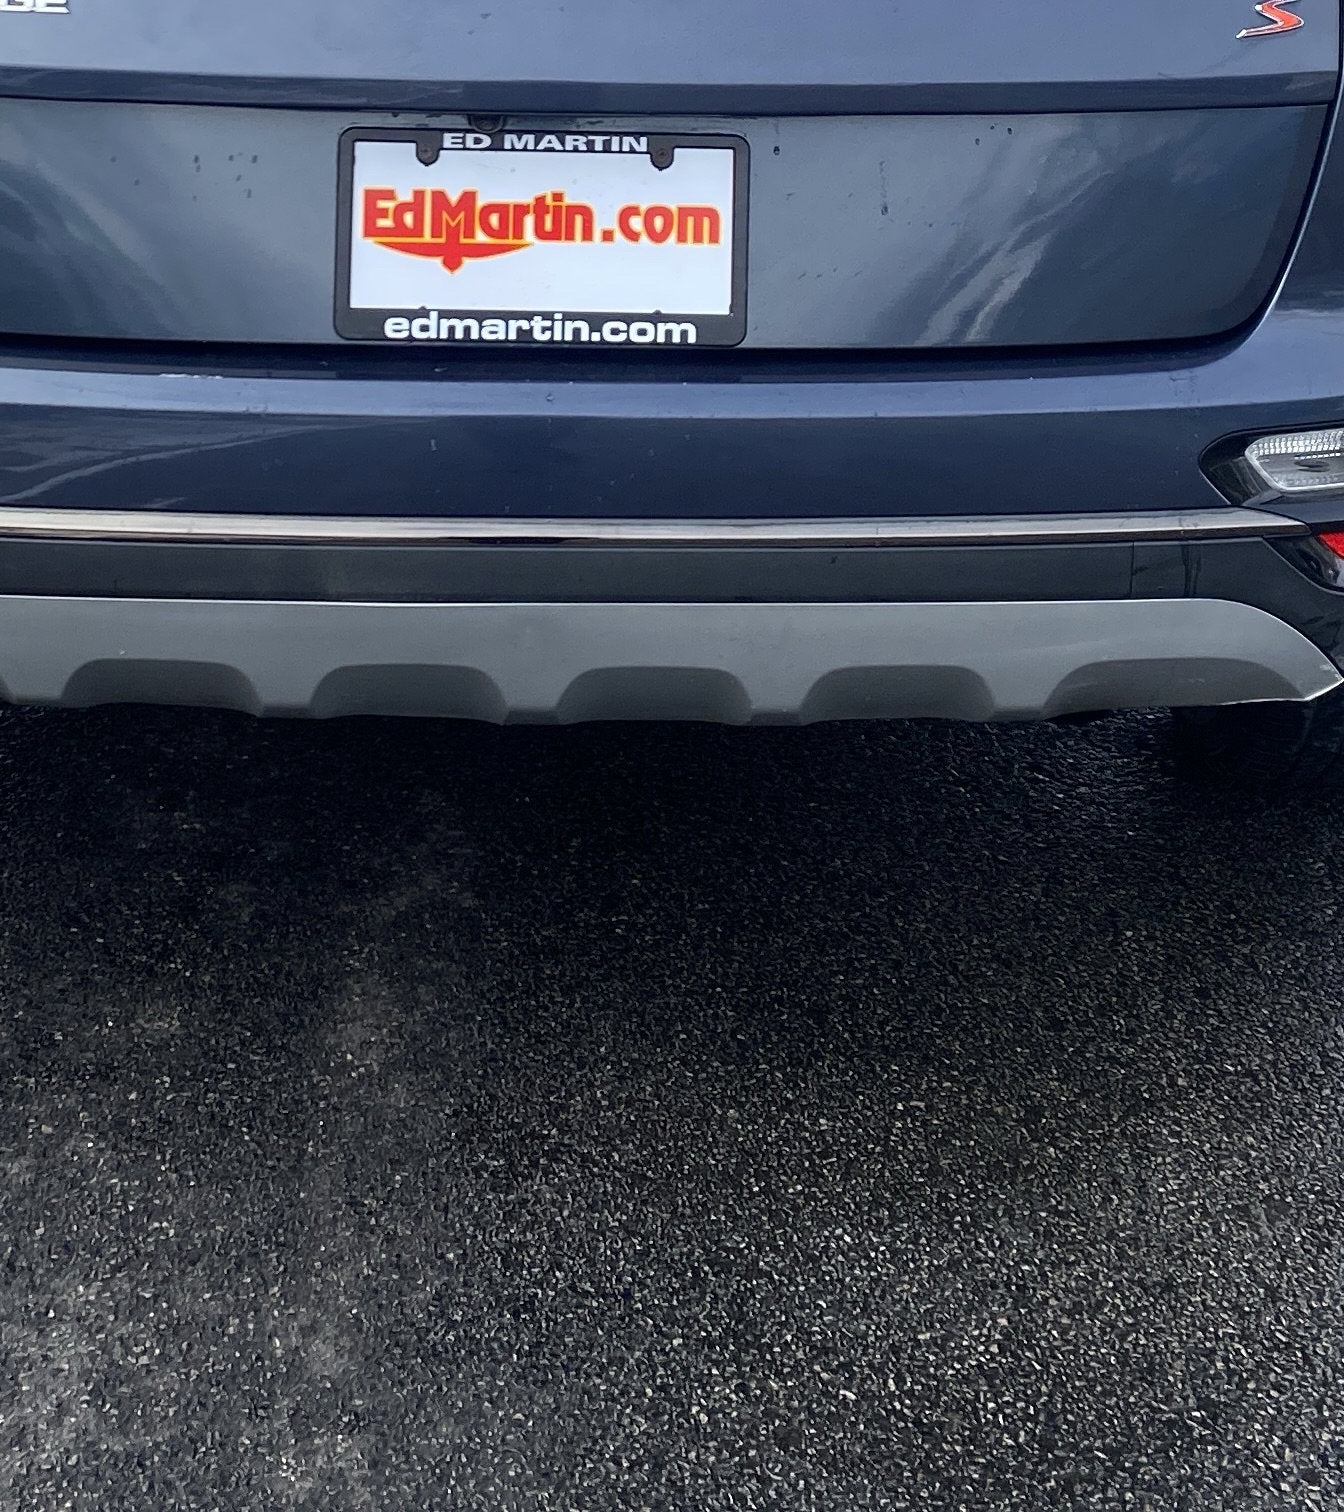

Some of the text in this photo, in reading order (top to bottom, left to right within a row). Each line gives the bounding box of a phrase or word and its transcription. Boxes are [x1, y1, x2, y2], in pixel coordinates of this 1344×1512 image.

[442, 132, 649, 153] ED MARTIN
[362, 186, 722, 247] EdMartin.com
[383, 311, 698, 345] edmartin.com
